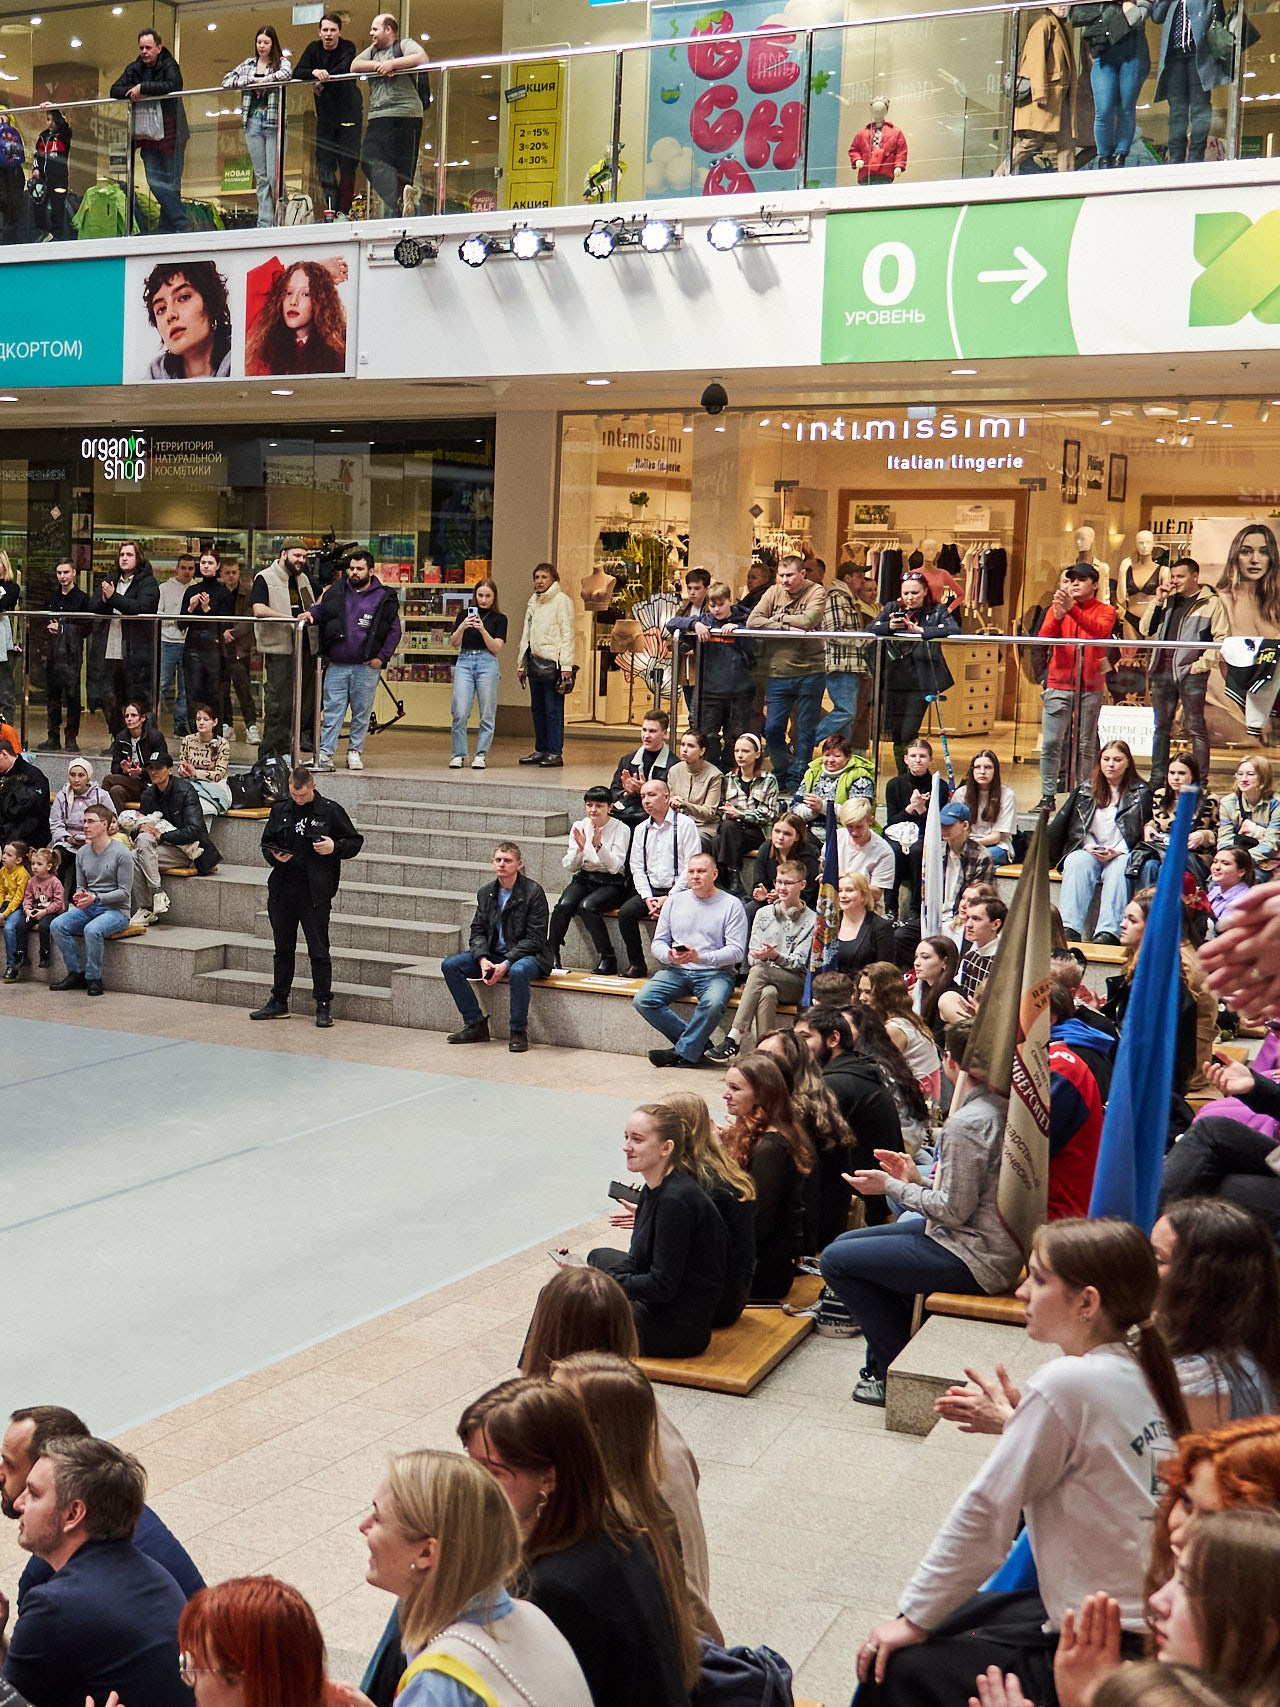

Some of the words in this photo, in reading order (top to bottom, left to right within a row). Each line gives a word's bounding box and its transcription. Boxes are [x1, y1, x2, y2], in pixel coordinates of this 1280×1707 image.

[225, 169, 251, 177] НОВАЯ
[845, 308, 926, 326] УРОВЕНЬ
[796, 416, 1025, 442] intimissimi
[81, 434, 146, 460] organic
[156, 440, 214, 452] ТЕРРИТОРИЯ
[155, 452, 222, 464] НАТУРАЛЬНОЙ
[887, 454, 944, 470] Italian
[951, 453, 1023, 472] lingerie
[103, 457, 145, 483] shop
[155, 465, 212, 477] КОСМЕТИКИ
